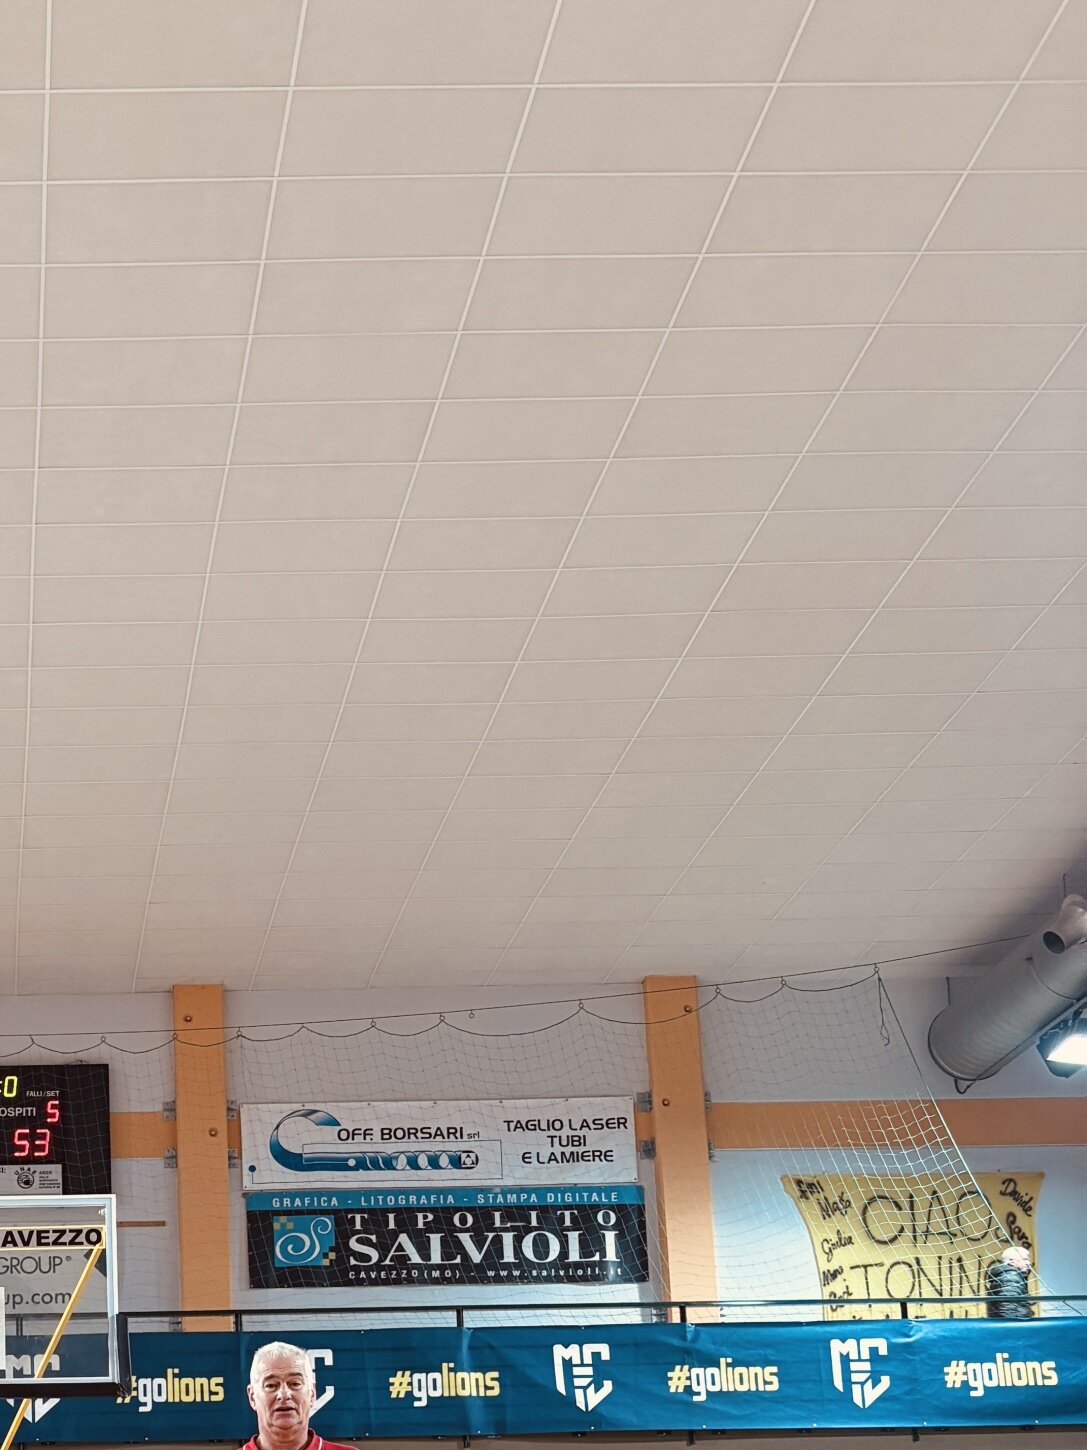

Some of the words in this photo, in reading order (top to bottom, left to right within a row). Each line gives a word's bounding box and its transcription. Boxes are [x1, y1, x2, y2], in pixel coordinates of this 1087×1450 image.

[26, 1090, 60, 1098] FALLI/SET
[46, 1100, 60, 1123] 5
[380, 1127, 464, 1140] BORSARI
[467, 1131, 480, 1140] srl
[503, 1119, 564, 1132] TAGLIO
[569, 1117, 628, 1131] LASER
[13, 1128, 51, 1157] 53
[546, 1135, 587, 1148] TUBI
[522, 1152, 532, 1164] E
[536, 1150, 614, 1164] LAMIERE
[272, 1196, 339, 1207] GRAFICA
[361, 1194, 455, 1206] LITOGRAFIA
[477, 1193, 538, 1204] STAMPA
[547, 1192, 618, 1203] DIGITALE
[348, 1210, 617, 1230] TIPOLITO
[862, 1189, 993, 1248] CIAO
[349, 1230, 621, 1266] SALVIOLI
[389, 1362, 500, 1408] #golions
[667, 1357, 779, 1401] #golions
[943, 1352, 1058, 1397] #golions
